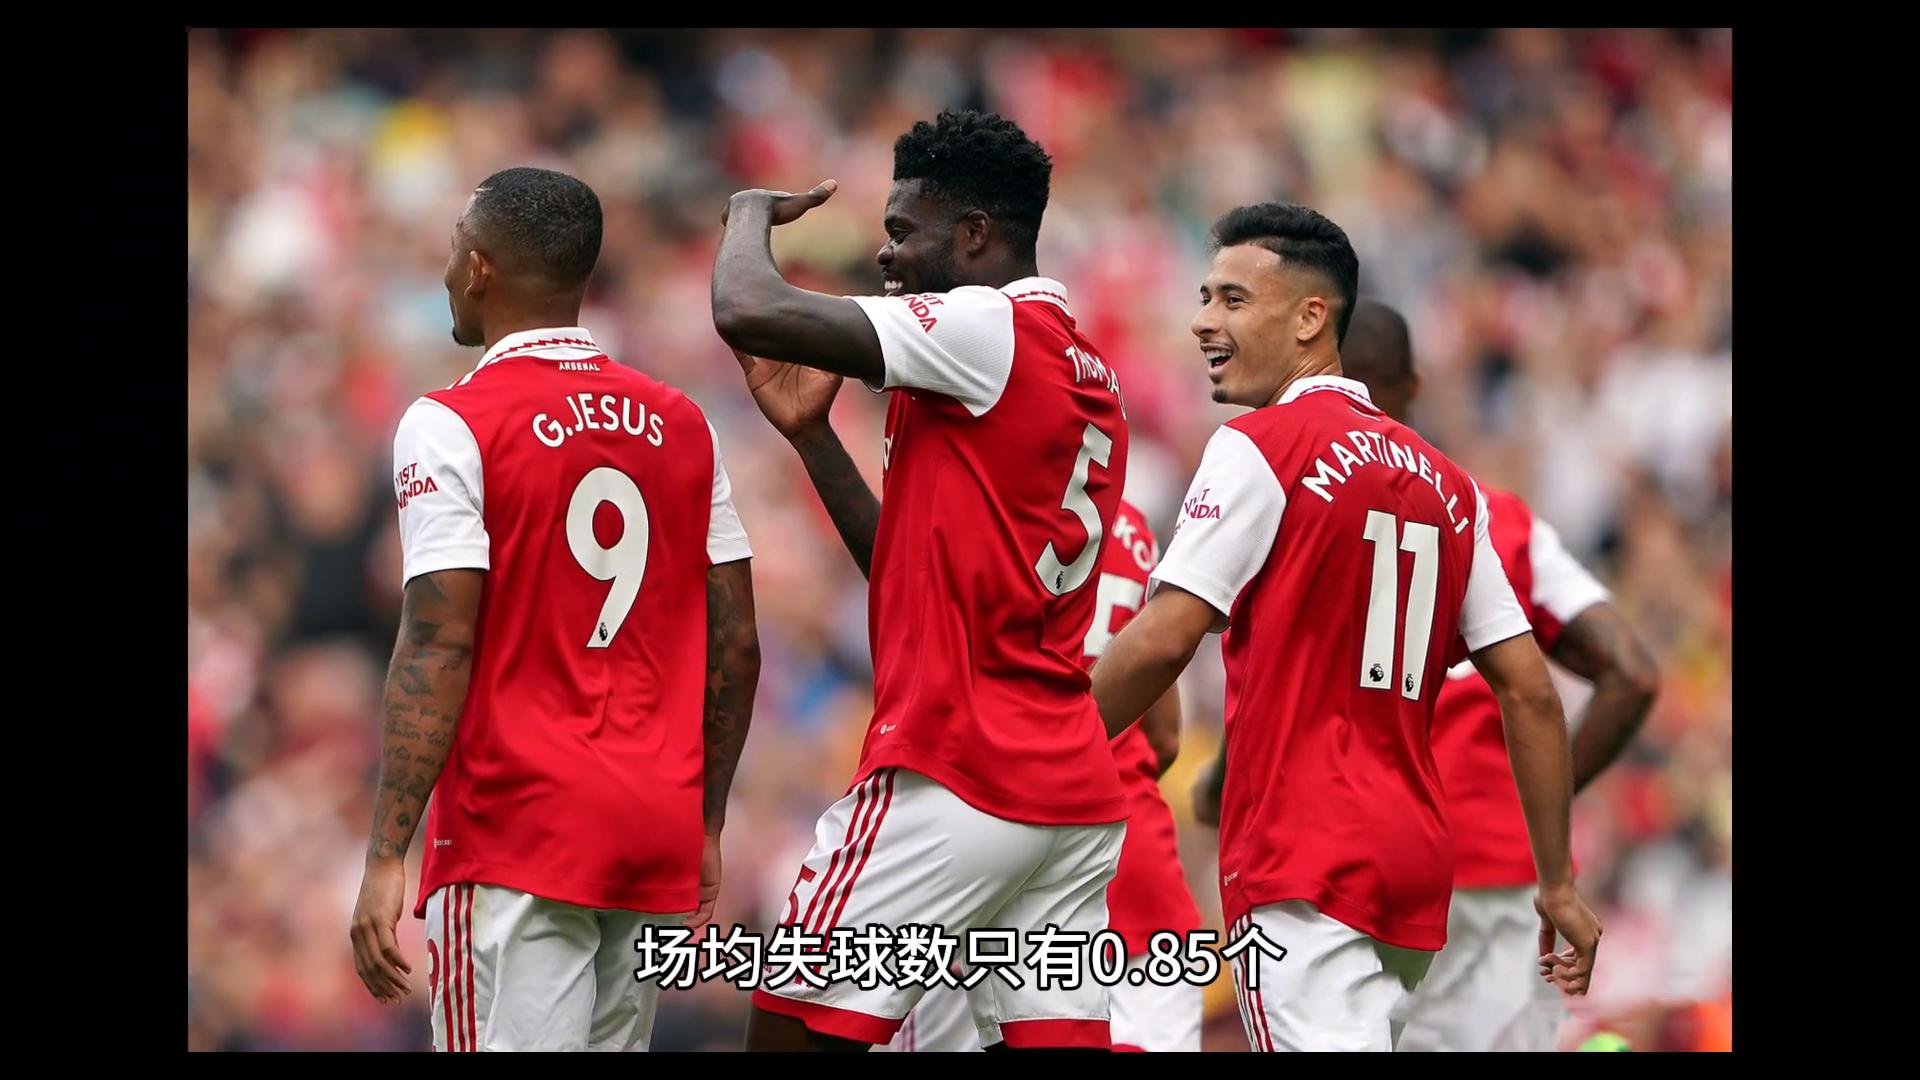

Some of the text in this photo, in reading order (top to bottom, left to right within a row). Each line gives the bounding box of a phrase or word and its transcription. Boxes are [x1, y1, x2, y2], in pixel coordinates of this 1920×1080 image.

[559, 361, 601, 371] ARSENAL
[532, 392, 664, 448] G.JESUS
[1034, 422, 1112, 596] 5
[1301, 430, 1469, 534] MARTINELLI
[565, 466, 649, 648] 9
[1112, 513, 1160, 571] KO
[1359, 509, 1440, 701] 11
